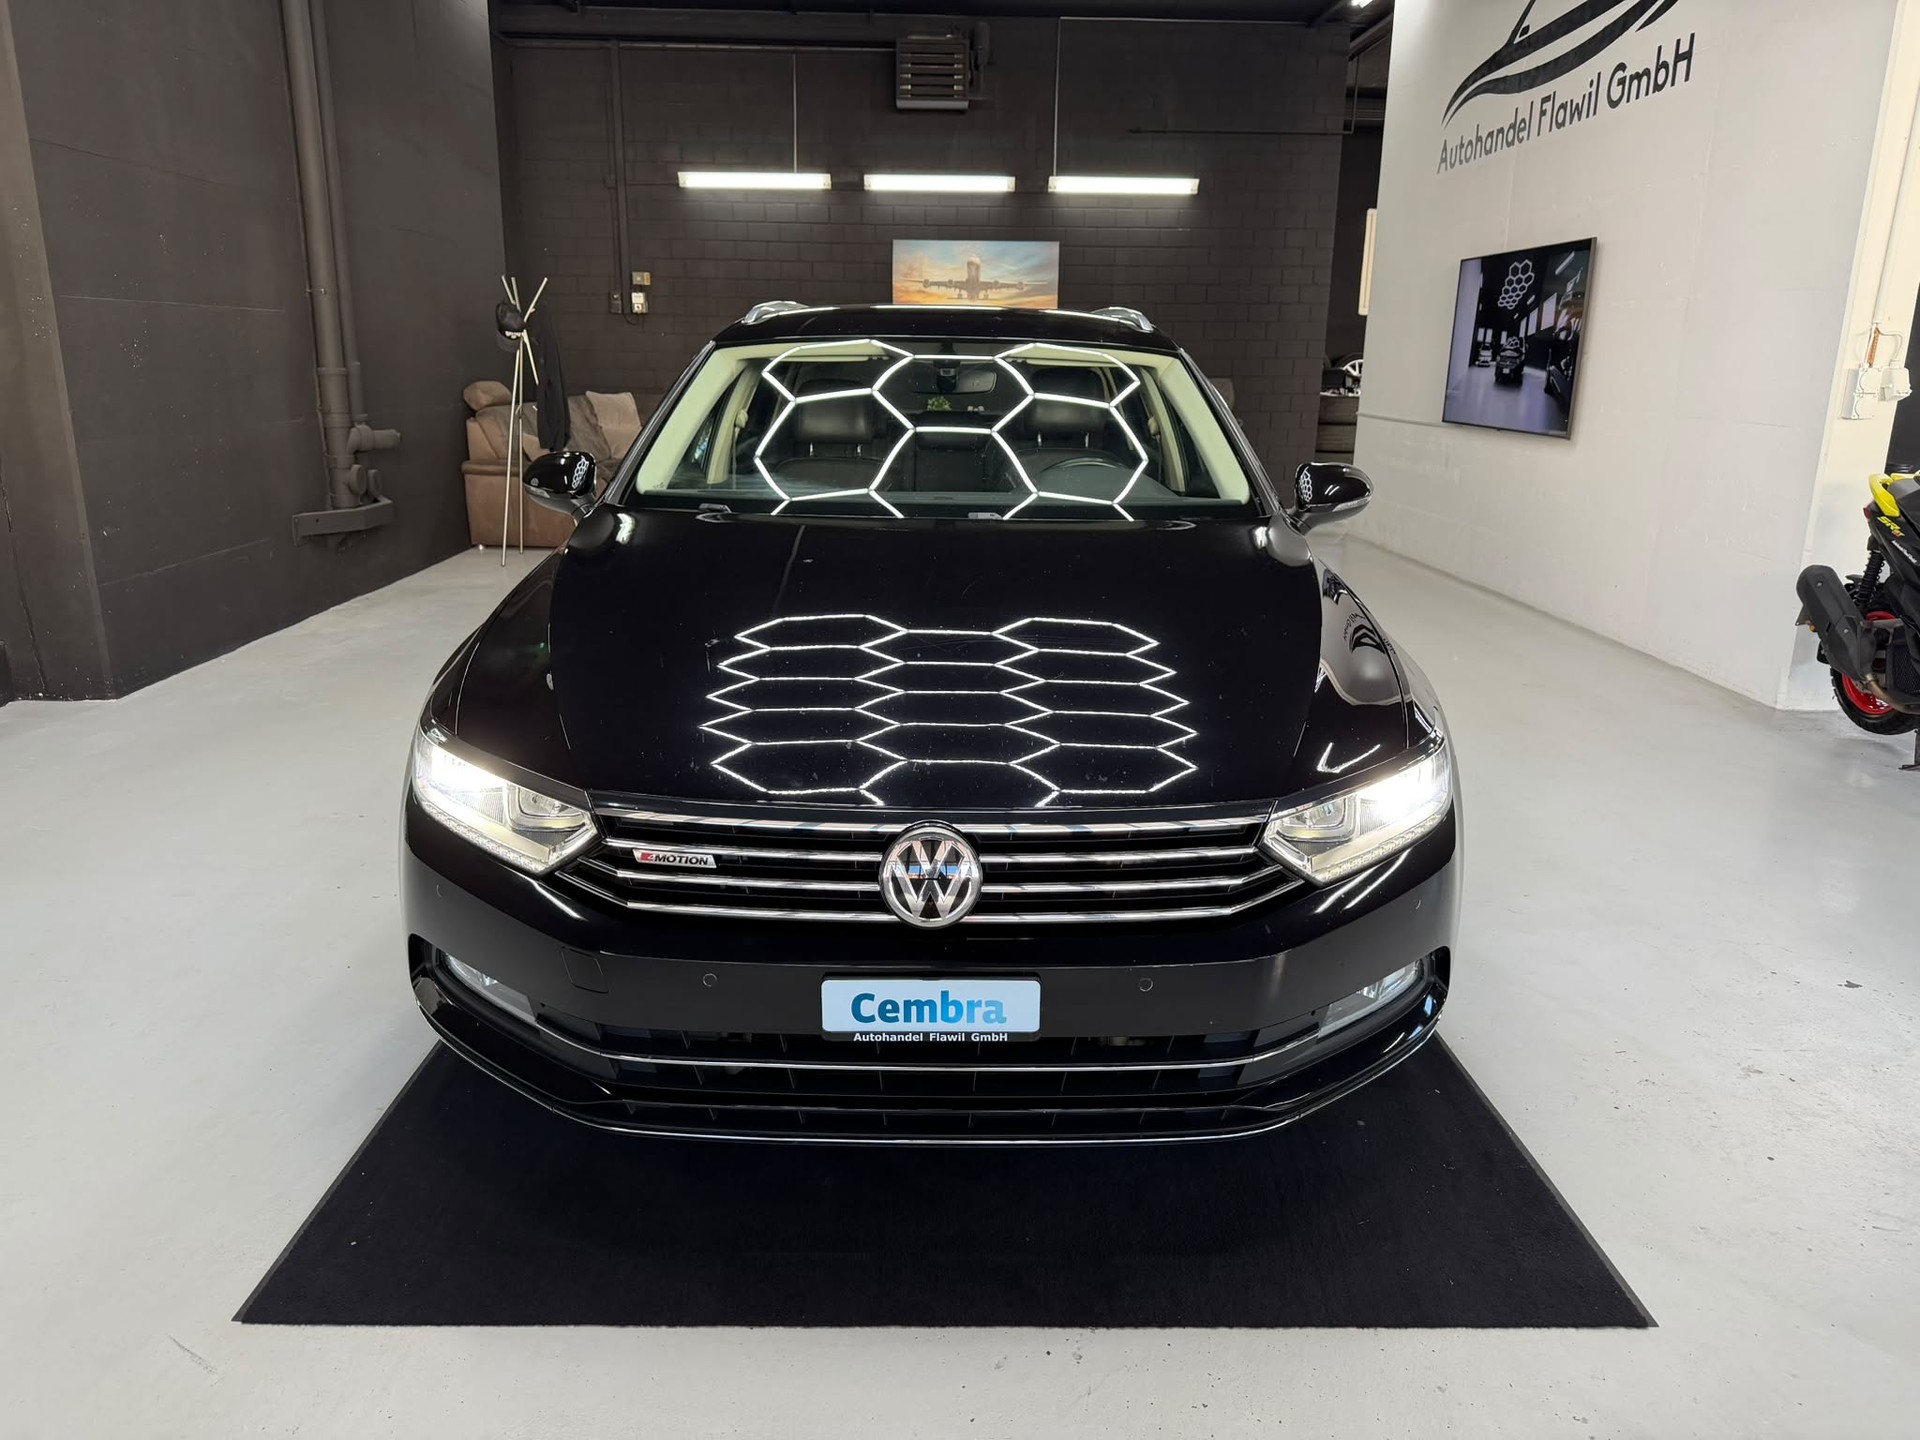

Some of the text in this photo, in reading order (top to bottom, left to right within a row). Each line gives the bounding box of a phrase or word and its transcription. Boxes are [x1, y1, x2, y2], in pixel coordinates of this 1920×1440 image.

[1437, 32, 1695, 174] Autohandel Flawil GmbH
[851, 990, 1007, 1024] Cembra
[853, 1033, 1008, 1042] Autohandel Flawil GmbH
